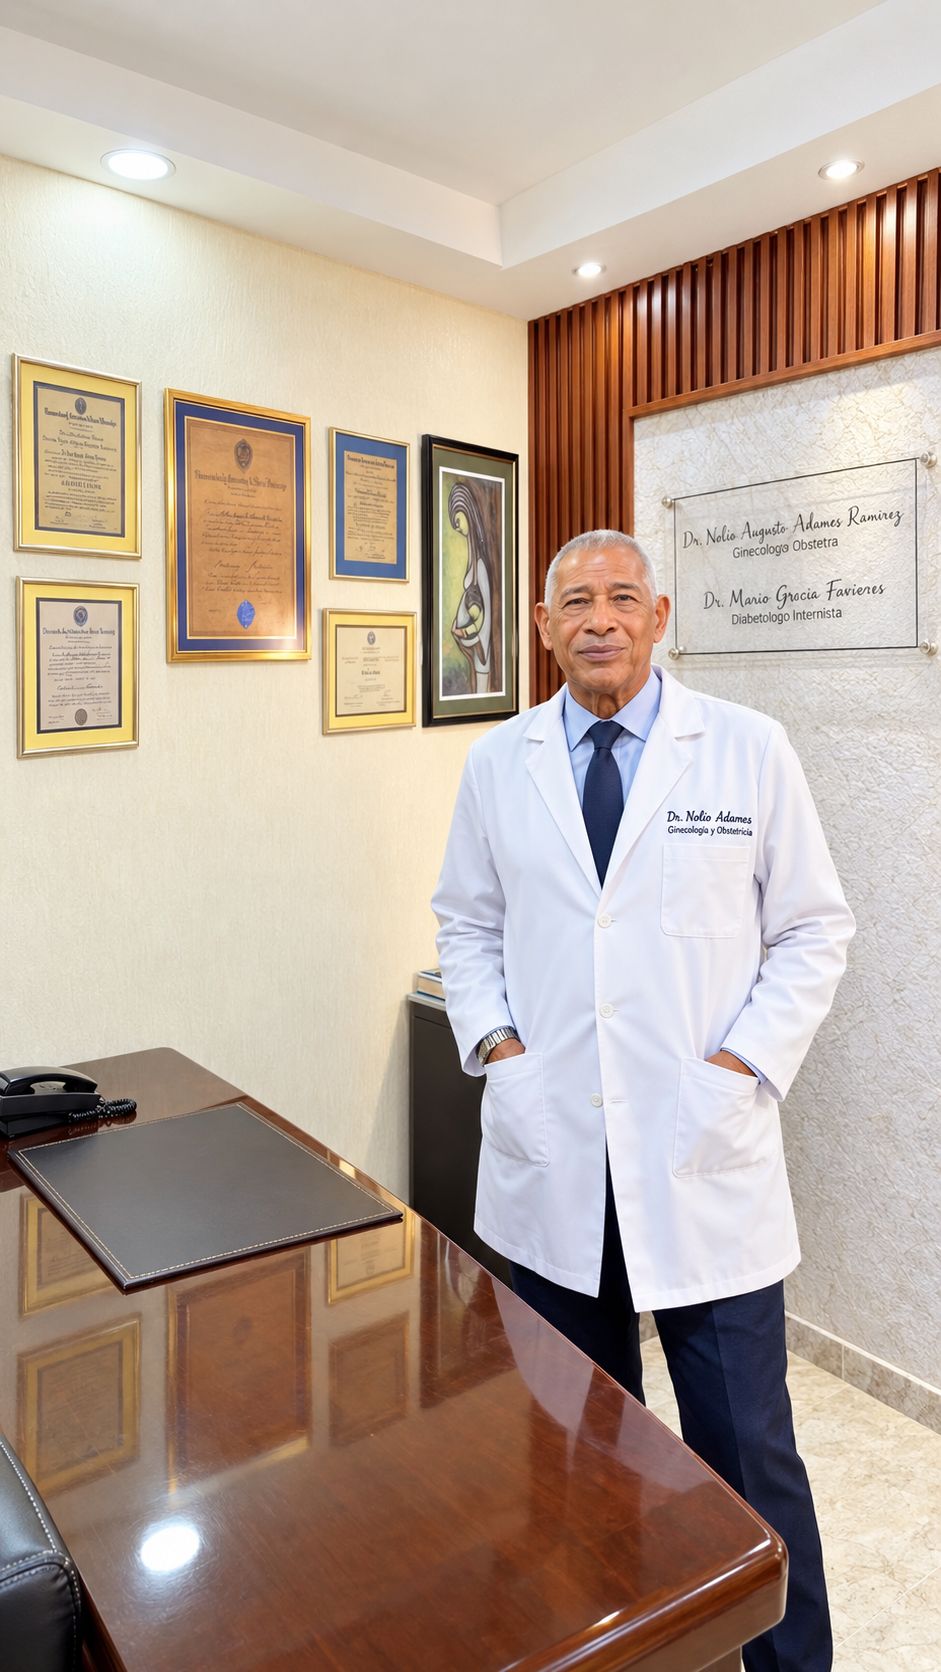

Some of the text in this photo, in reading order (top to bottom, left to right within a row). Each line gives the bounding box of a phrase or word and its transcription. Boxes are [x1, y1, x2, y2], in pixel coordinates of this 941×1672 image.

[682, 505, 904, 549] Dr. Nolio Augusto Adames Ramirez
[793, 537, 839, 552] Obstetra
[704, 591, 724, 609] Dr.
[729, 588, 771, 609] Mario
[731, 607, 842, 625] Diabetologo Internista
[667, 810, 752, 824] Dr. Nolio Adames
[710, 828, 716, 836] y
[716, 825, 753, 836] Obstetricia
